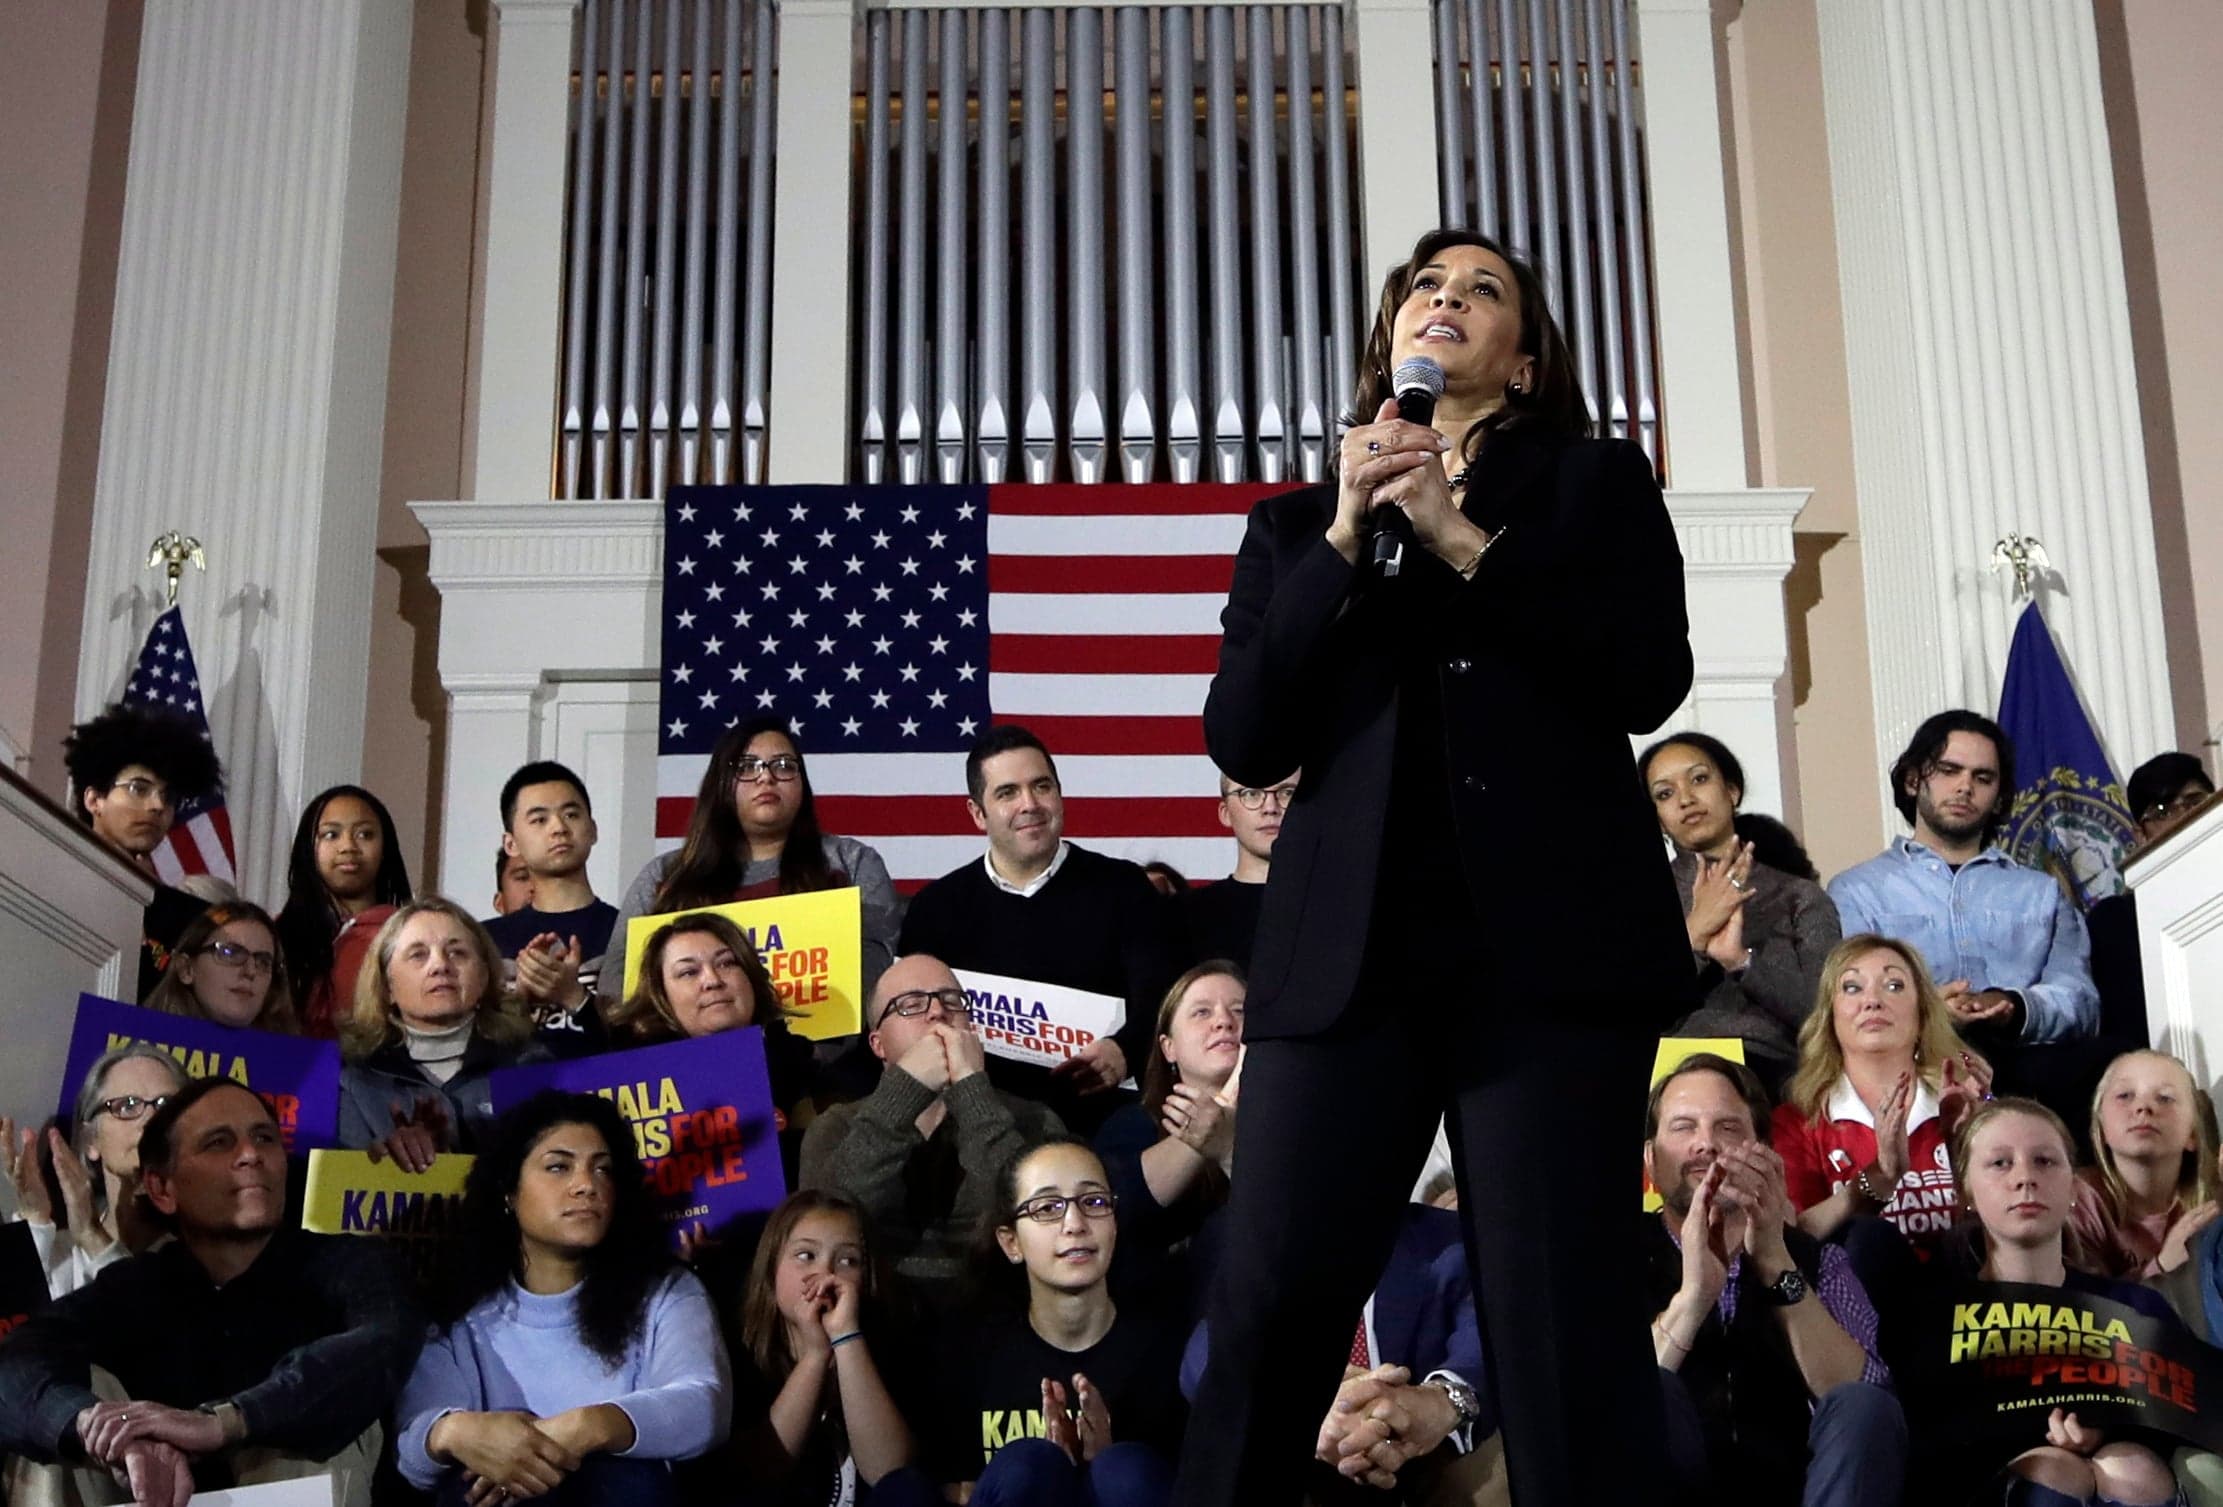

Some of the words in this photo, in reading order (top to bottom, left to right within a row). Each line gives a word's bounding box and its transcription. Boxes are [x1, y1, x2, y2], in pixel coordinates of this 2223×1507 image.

[772, 947, 828, 981] FOR
[775, 976, 829, 1007] PLE
[967, 988, 1049, 1022] MALA
[969, 1008, 1037, 1036] RRIS
[1038, 1021, 1095, 1047] FOR
[984, 1027, 1075, 1060] PEOPL
[670, 1106, 741, 1152] FOR
[1953, 1302, 2134, 1344] KAMALA
[1950, 1329, 2113, 1364] HARRIS
[2113, 1340, 2196, 1386] FOR
[2030, 1355, 2199, 1413] PEOPLE
[1997, 1393, 2147, 1412] KAMALAHARRIS.ORG
